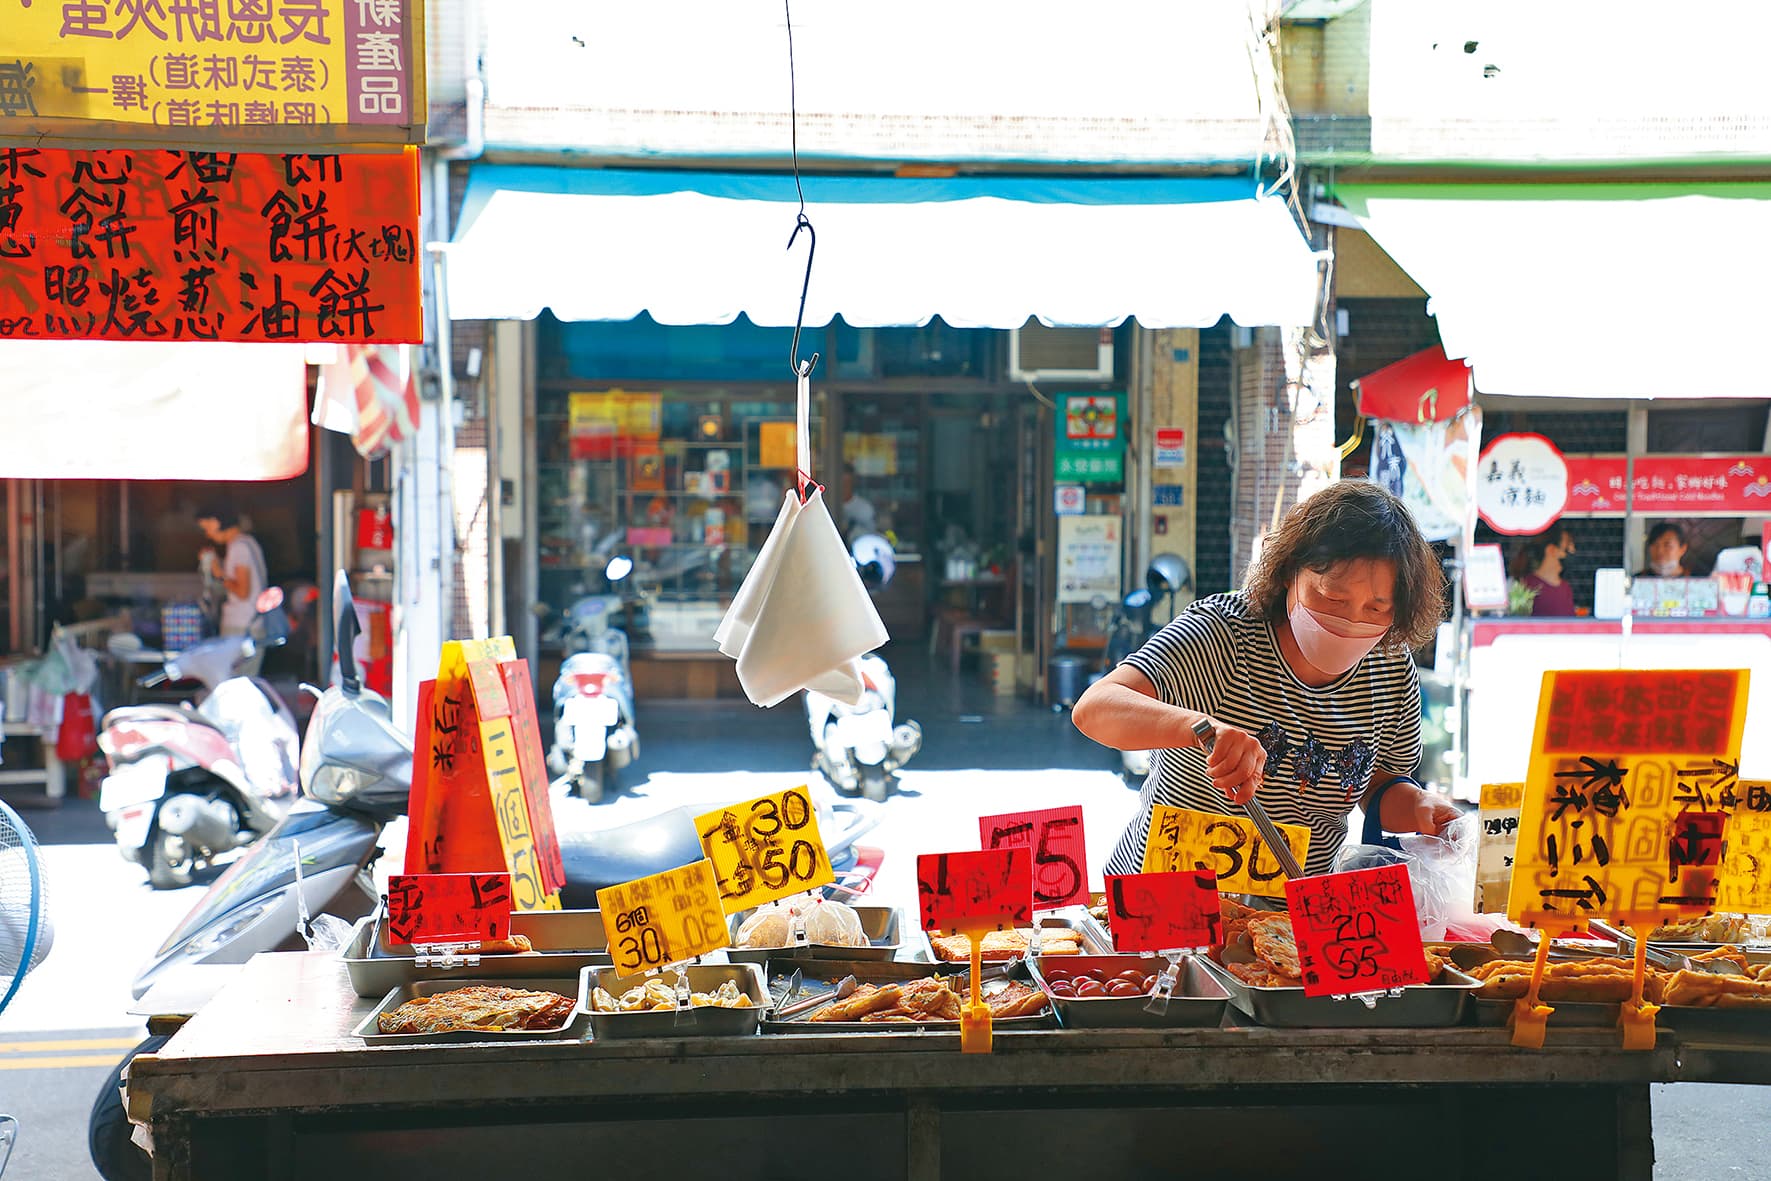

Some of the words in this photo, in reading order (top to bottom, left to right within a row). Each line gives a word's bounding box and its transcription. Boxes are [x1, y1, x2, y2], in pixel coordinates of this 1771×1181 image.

[750, 790, 810, 837] 30
[762, 839, 816, 890] 50
[1194, 820, 1292, 882] 30
[615, 905, 649, 933] 6個
[1336, 945, 1379, 980] 55
